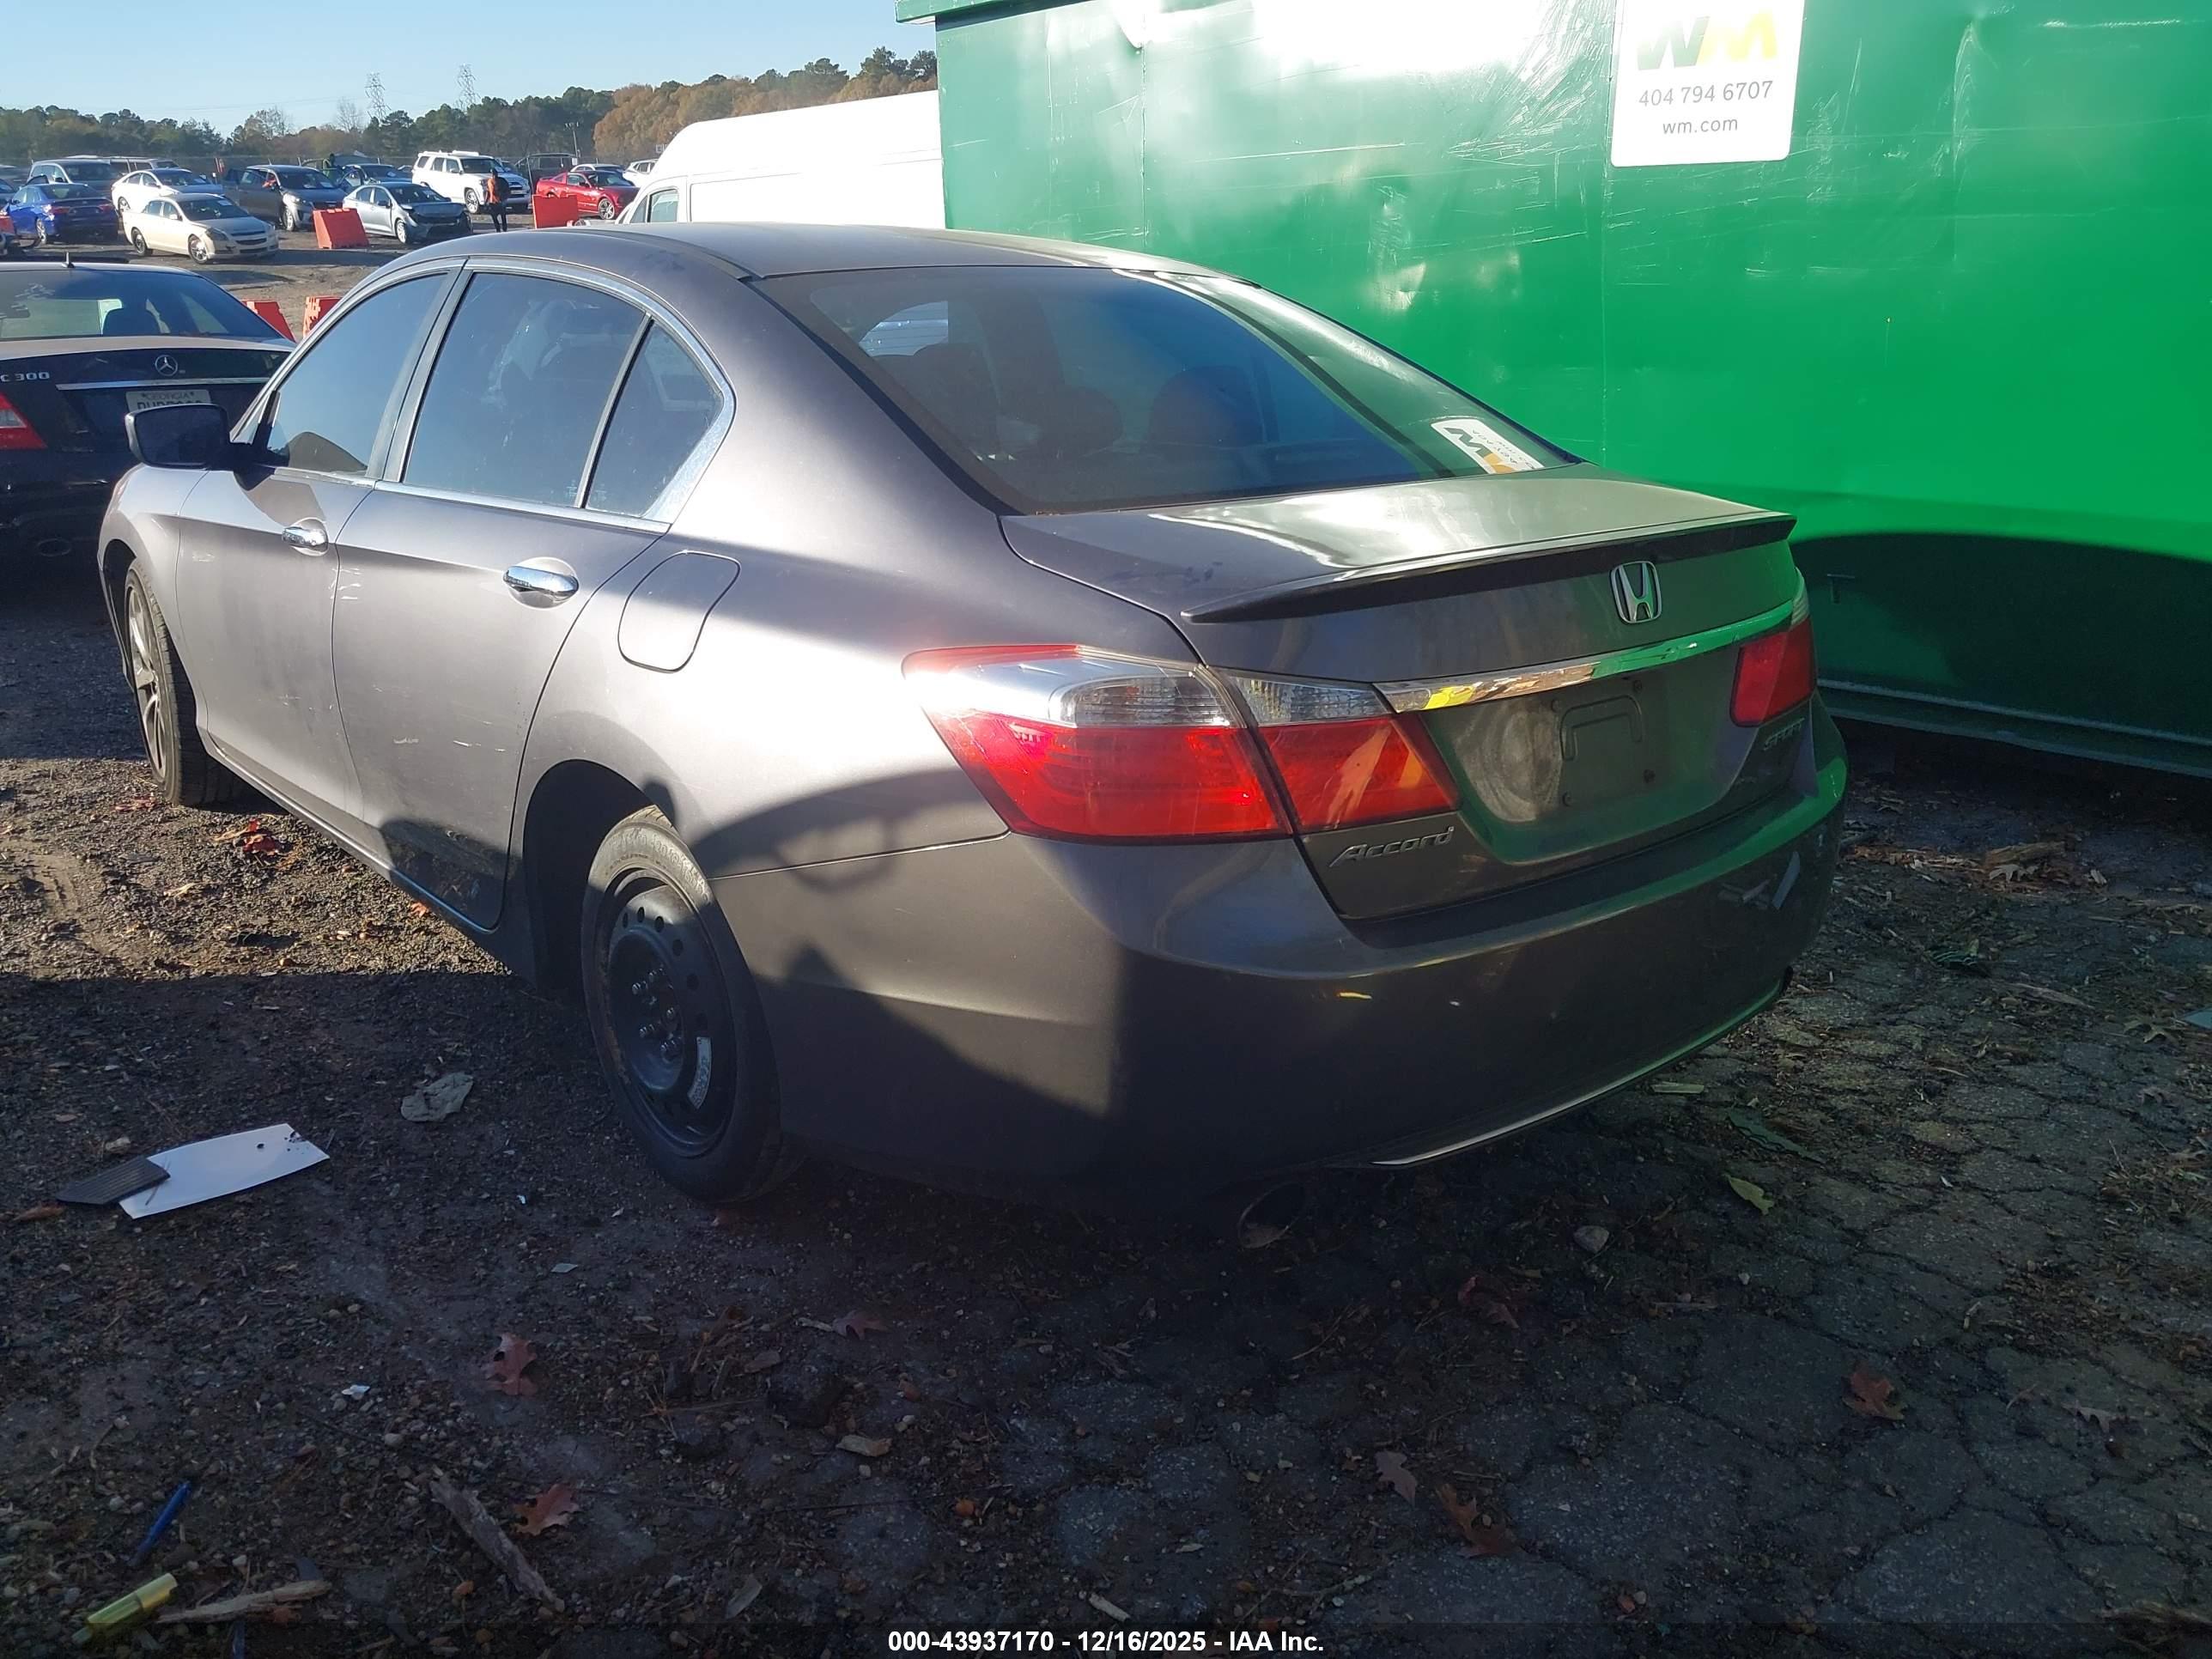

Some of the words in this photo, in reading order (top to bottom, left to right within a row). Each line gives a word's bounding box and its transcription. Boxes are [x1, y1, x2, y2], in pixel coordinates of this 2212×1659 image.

[1638, 88, 1674, 106] 404
[1681, 85, 1716, 104] 794
[1723, 81, 1773, 101] 6707
[1662, 118, 1738, 135] wm.com
[0, 374, 9, 382] C
[15, 372, 50, 380] 300
[1329, 826, 1455, 868] Accord
